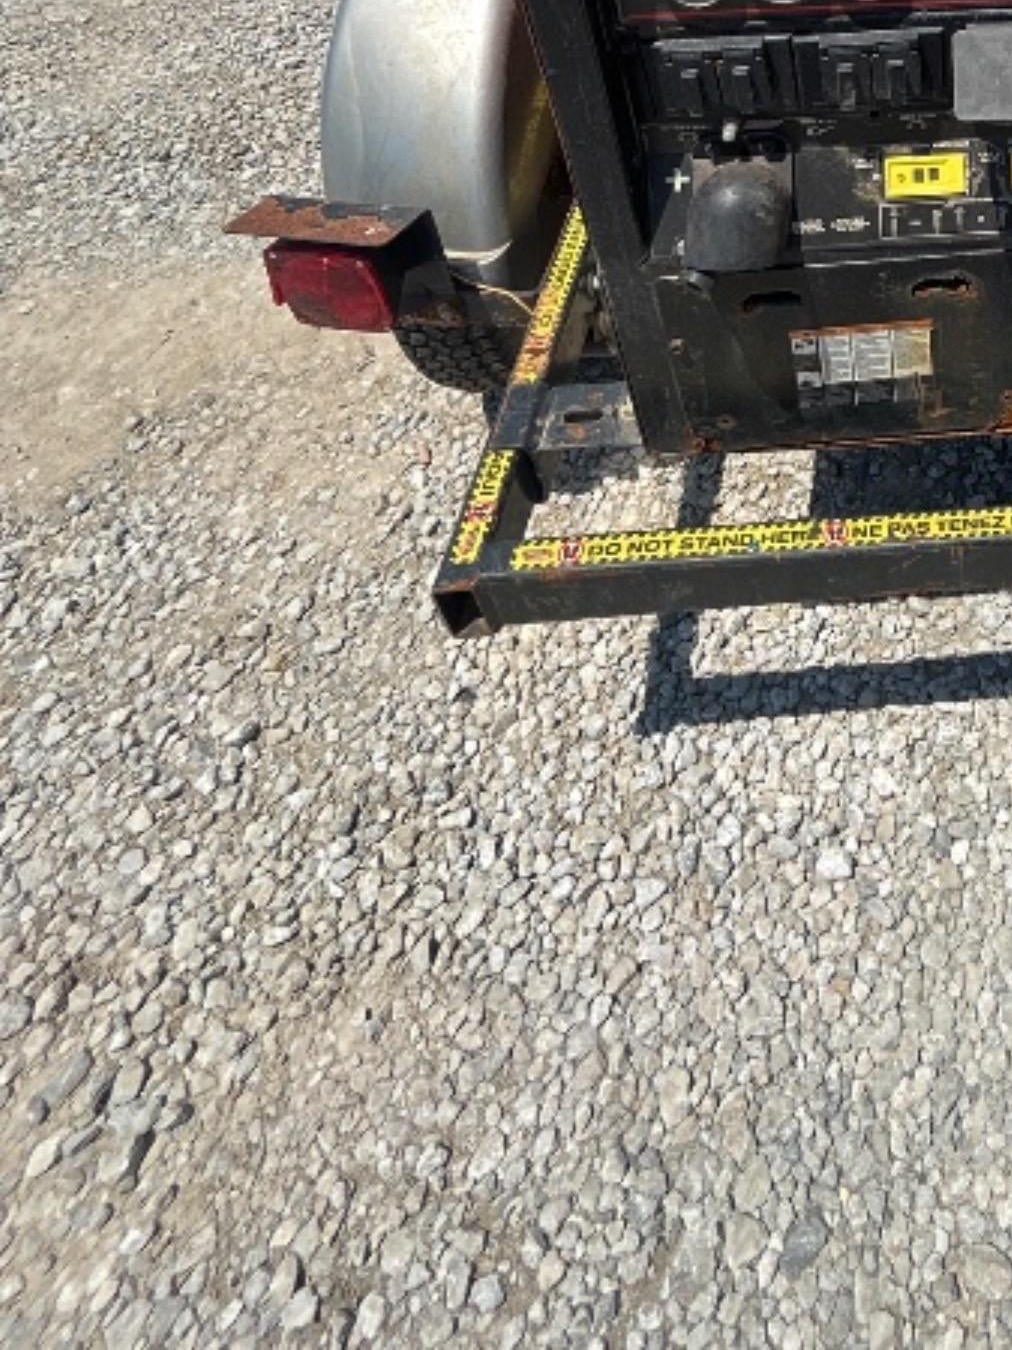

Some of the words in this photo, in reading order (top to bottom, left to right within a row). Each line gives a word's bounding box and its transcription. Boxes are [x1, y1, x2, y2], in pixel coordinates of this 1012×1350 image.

[588, 542, 622, 556] DO
[627, 538, 672, 553] NOT
[679, 533, 755, 550] STAND
